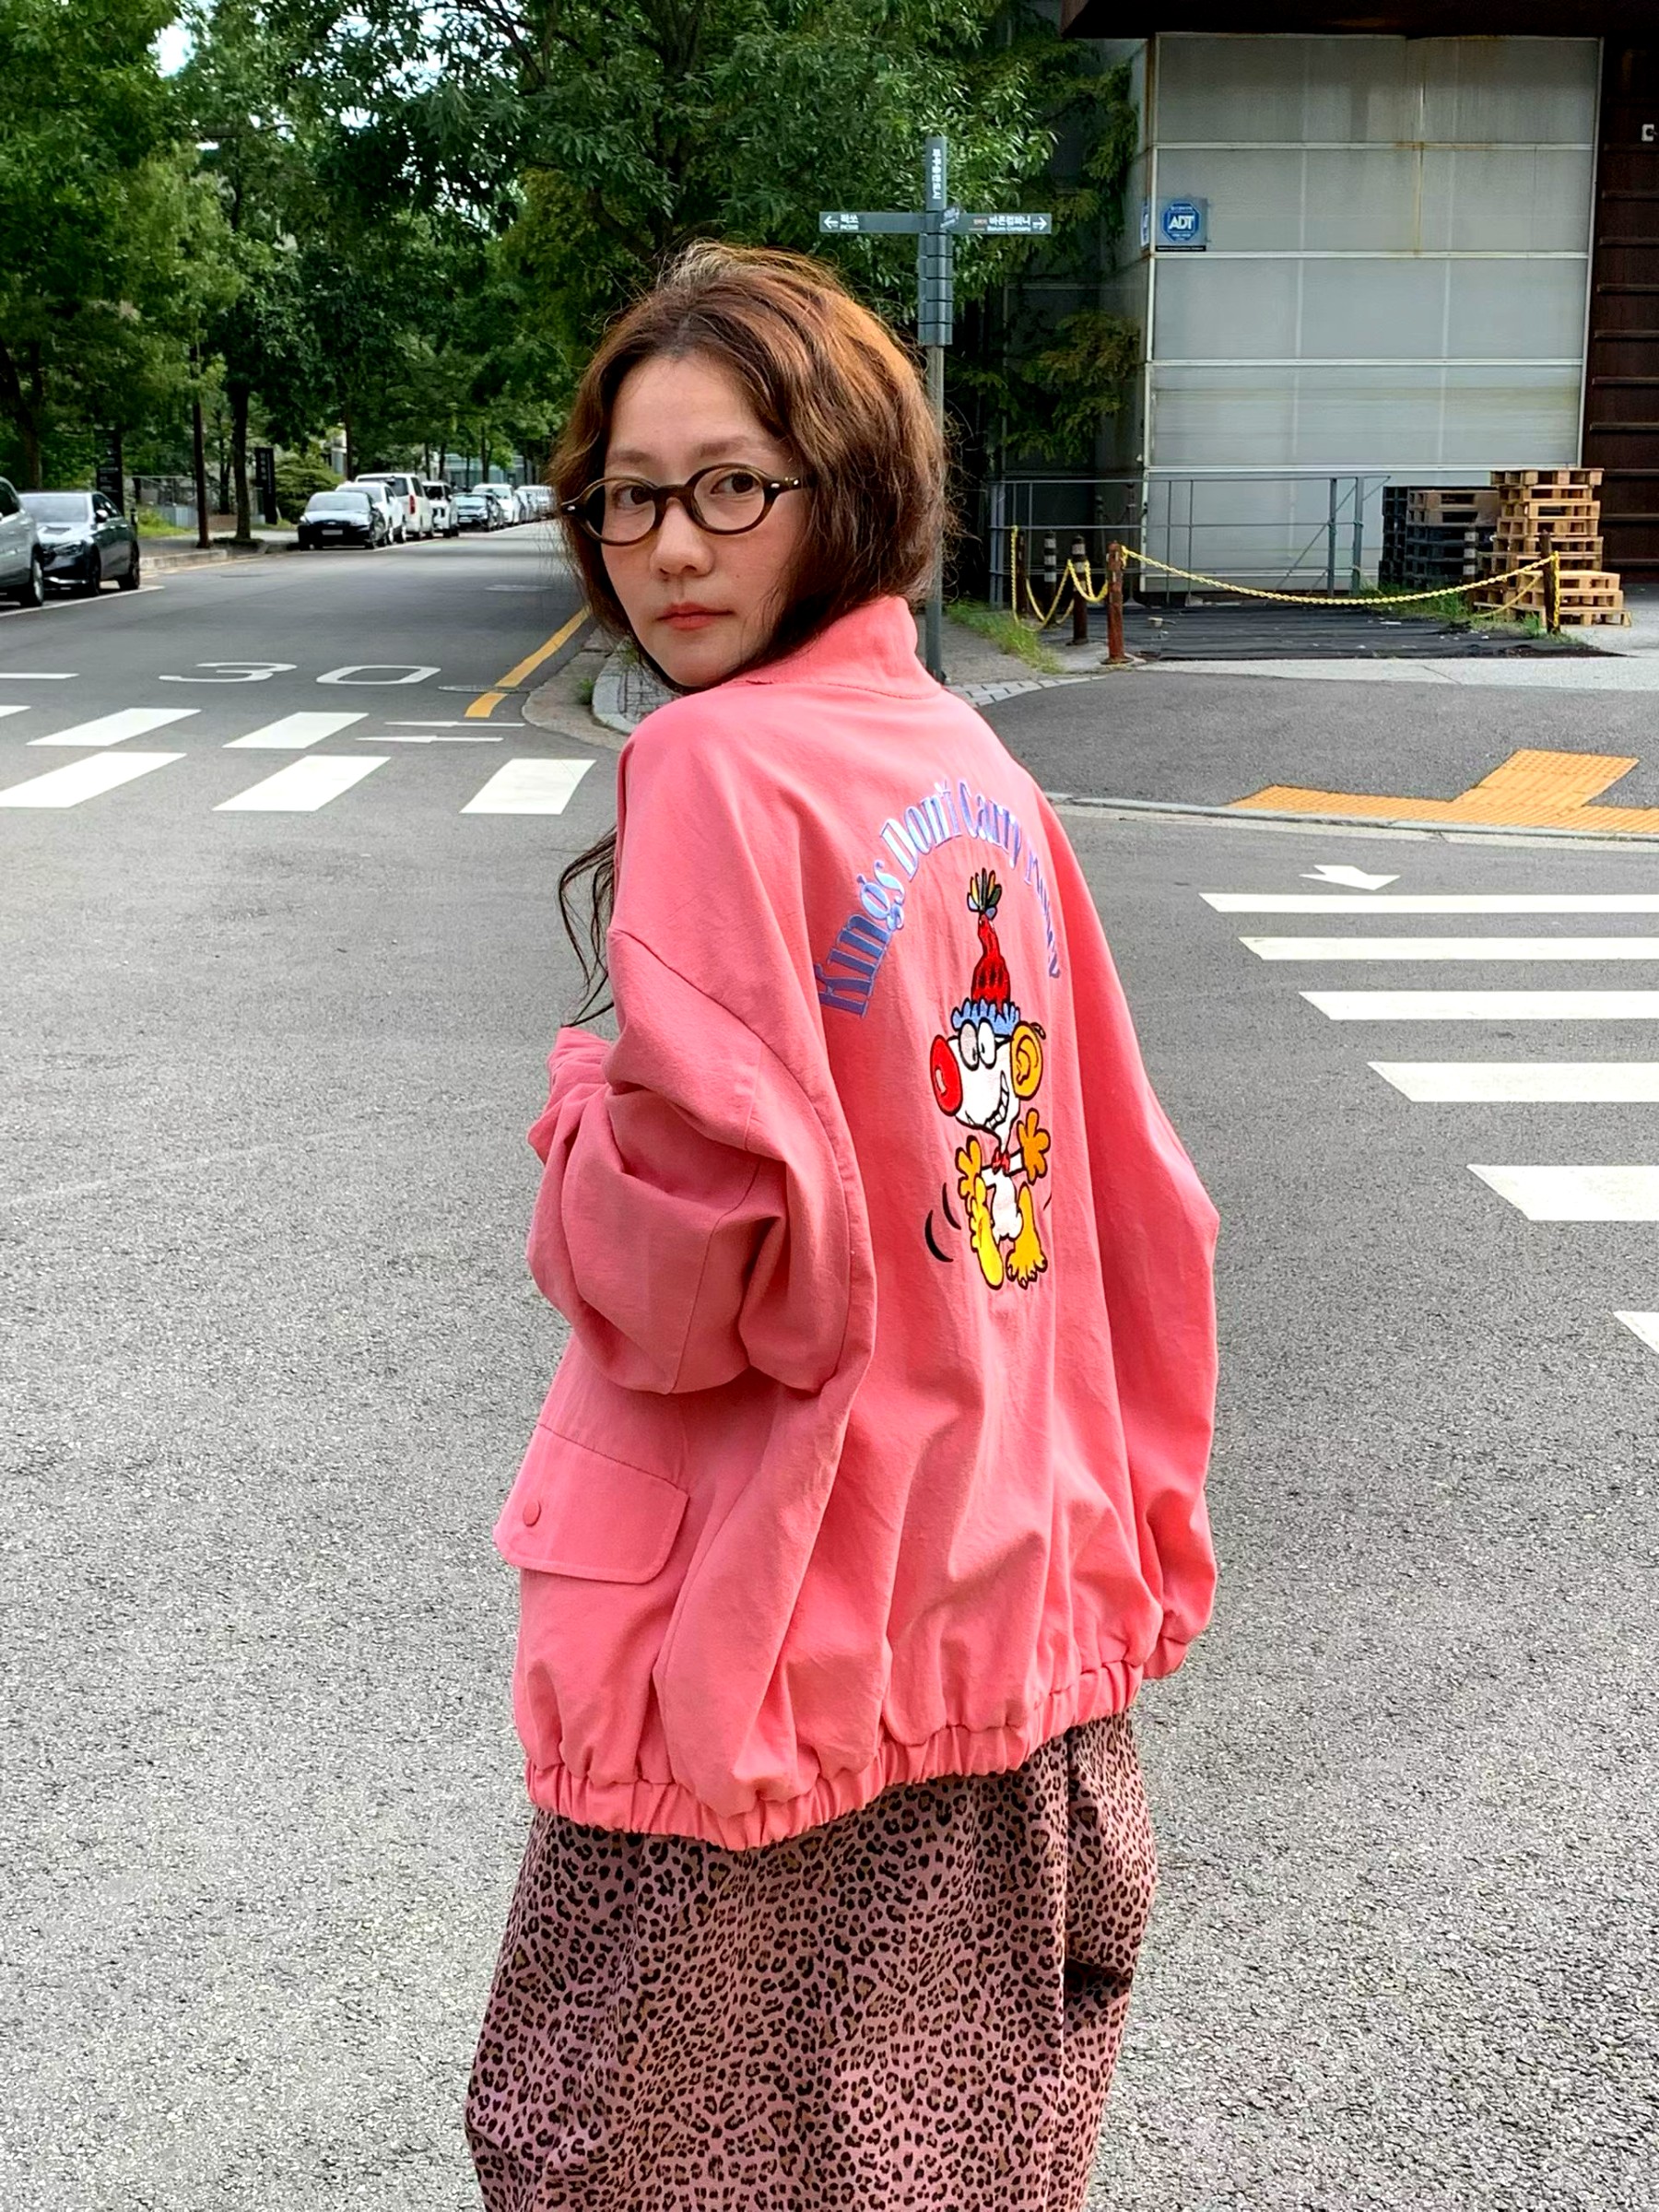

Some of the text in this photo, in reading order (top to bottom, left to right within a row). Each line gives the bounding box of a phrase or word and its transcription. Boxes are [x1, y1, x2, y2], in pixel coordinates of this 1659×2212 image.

[1168, 215, 1194, 229] ADT
[159, 662, 442, 685] 30
[814, 858, 905, 1018] Kings
[879, 779, 962, 882] Don't
[959, 781, 1022, 871] Carry
